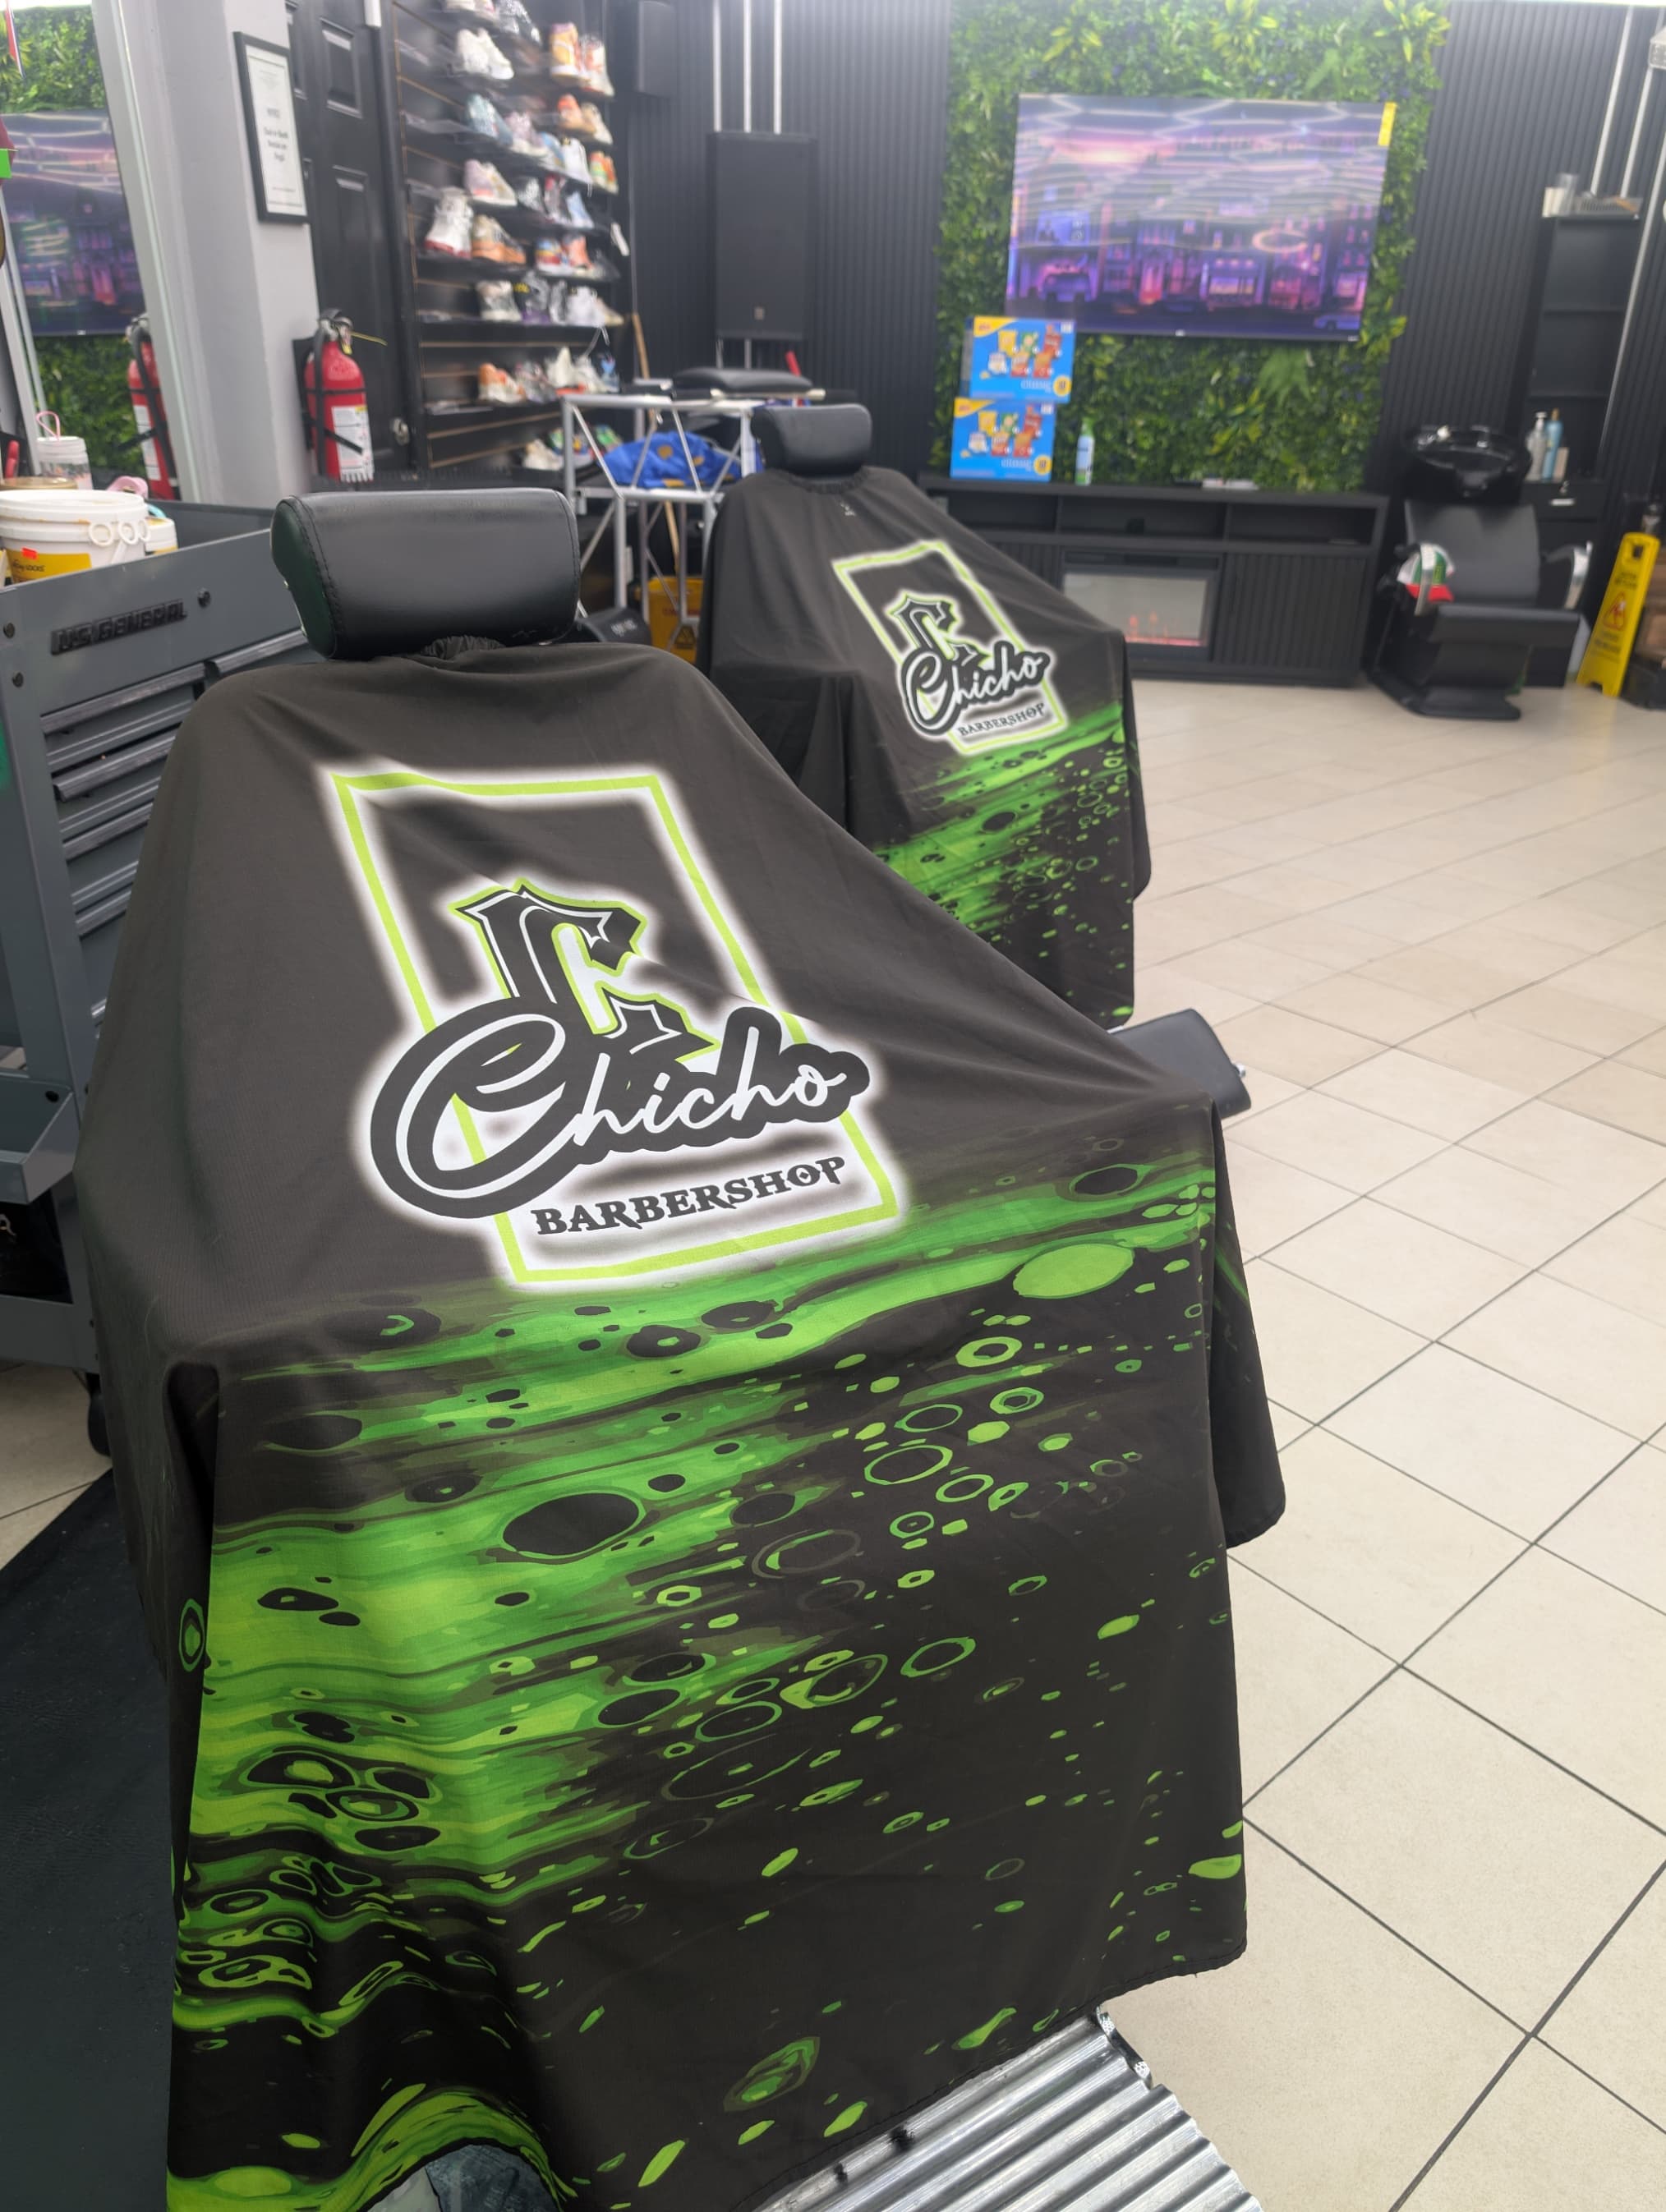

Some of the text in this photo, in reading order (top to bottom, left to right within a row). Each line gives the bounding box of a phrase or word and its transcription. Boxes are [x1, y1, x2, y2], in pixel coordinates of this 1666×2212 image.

[904, 642, 1044, 730] Chicho
[957, 702, 1046, 737] BARBERSHOP
[389, 1010, 853, 1203] Chicho
[531, 1156, 845, 1235] BARBERSHOP
